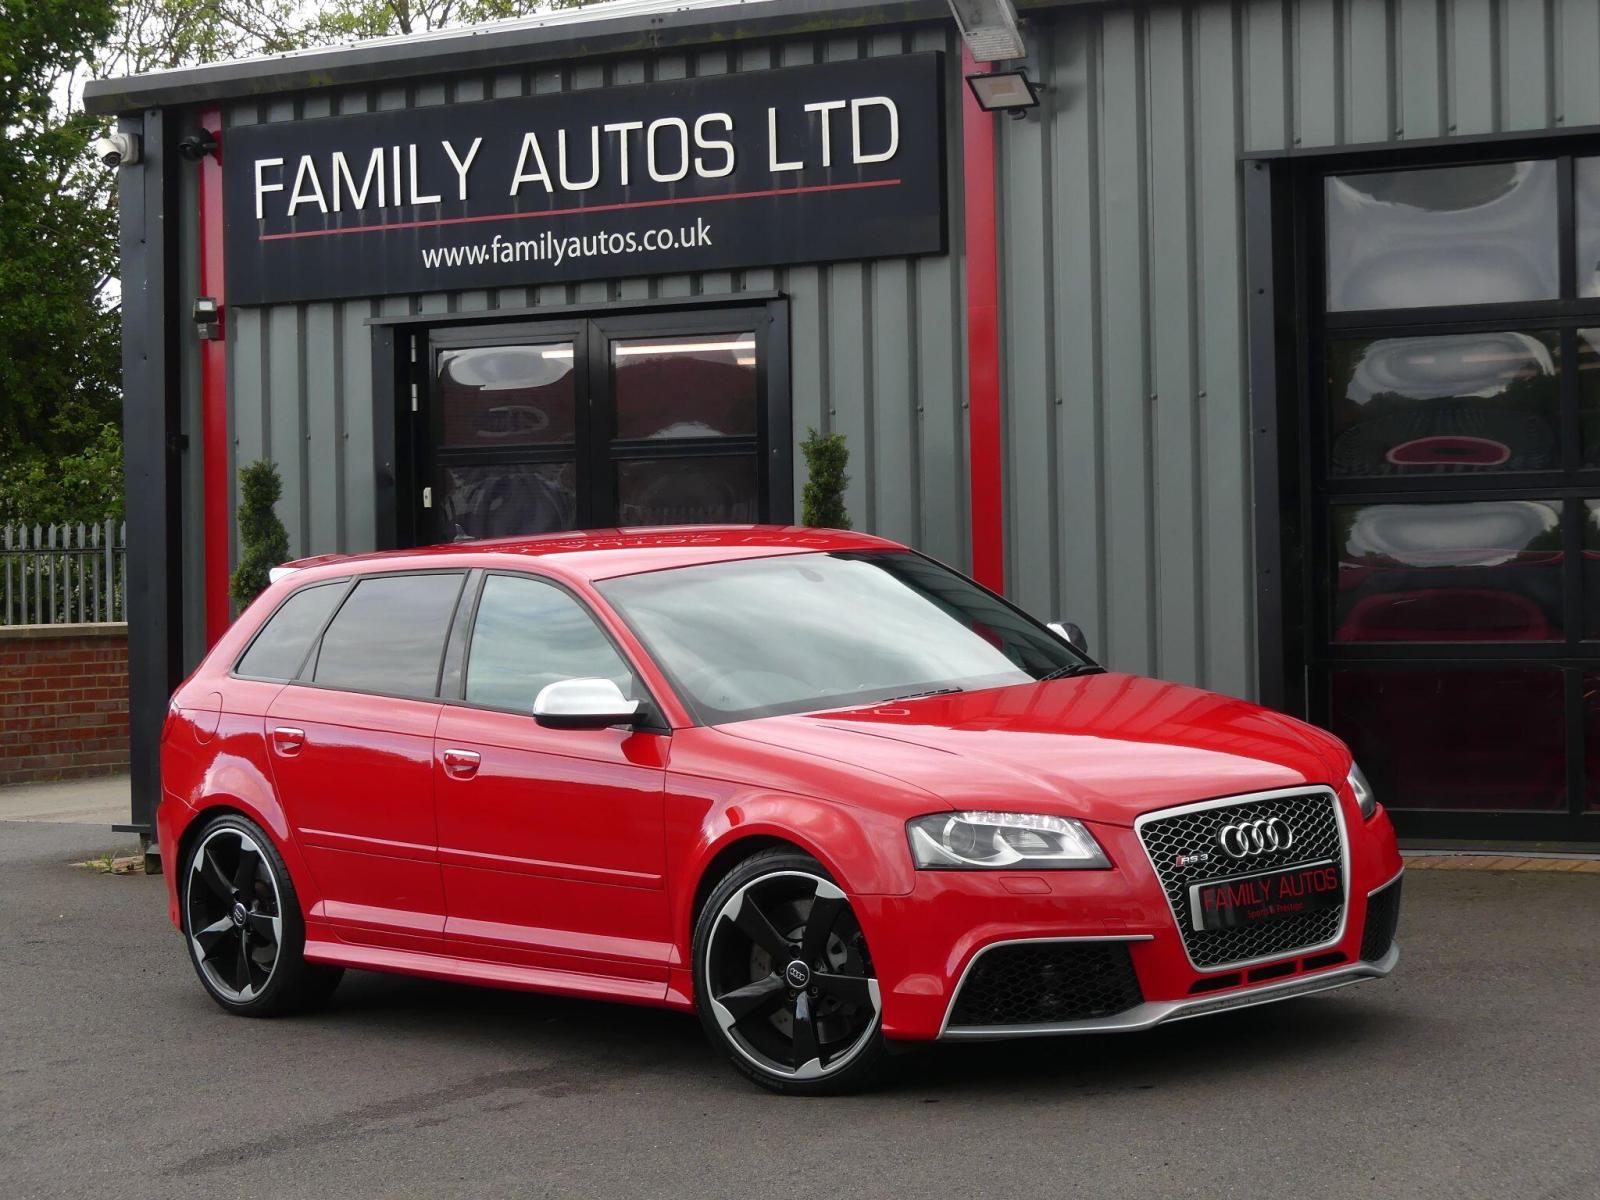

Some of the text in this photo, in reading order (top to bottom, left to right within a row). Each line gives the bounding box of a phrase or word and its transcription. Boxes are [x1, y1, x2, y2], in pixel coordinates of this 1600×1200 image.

[254, 96, 900, 220] FAMILY AUTOS LTD
[421, 217, 713, 269] www.familyautos.co.uk
[1203, 868, 1338, 911] FAMILY AUTOS
